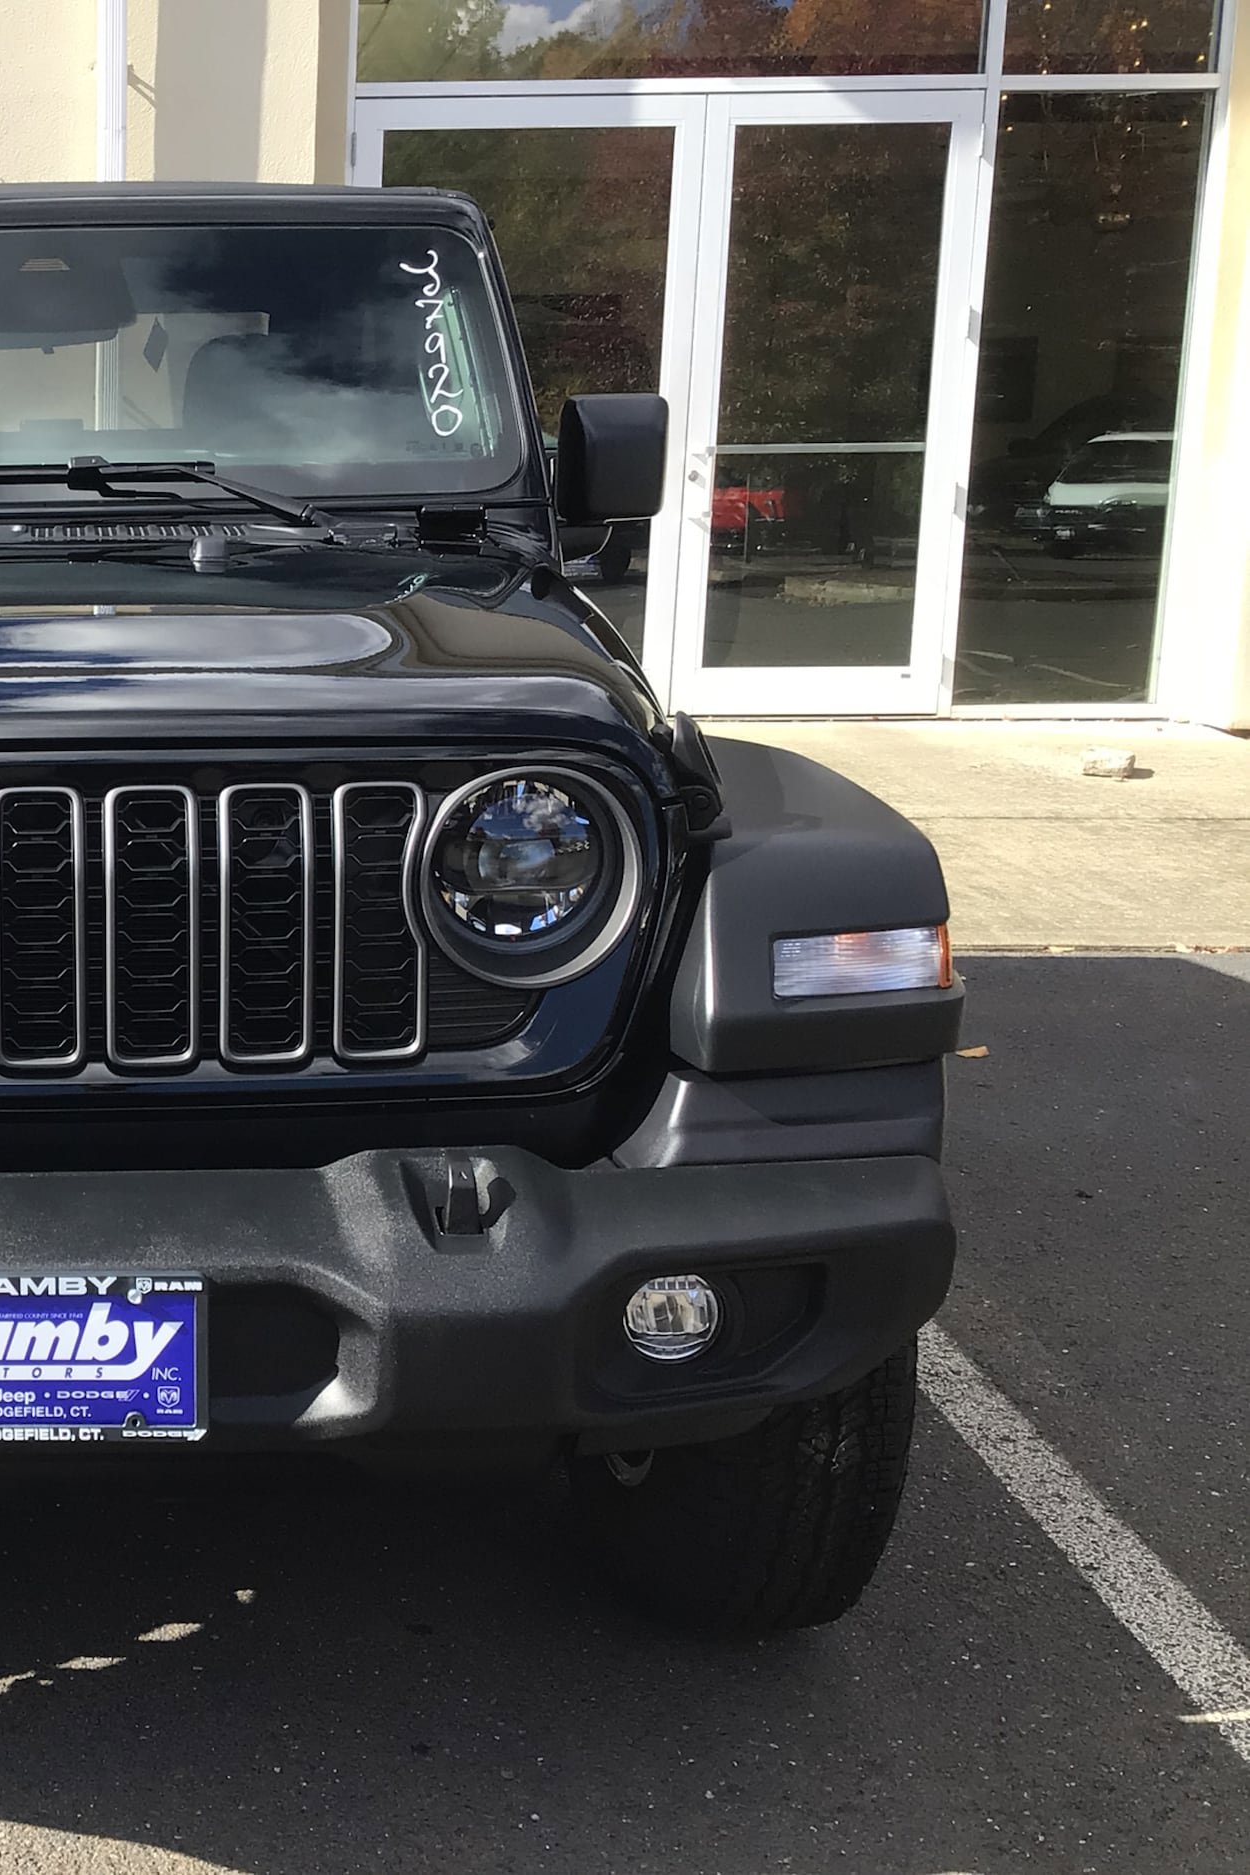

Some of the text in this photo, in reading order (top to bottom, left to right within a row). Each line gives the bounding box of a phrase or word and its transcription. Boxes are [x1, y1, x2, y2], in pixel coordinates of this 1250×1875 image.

[154, 1281, 203, 1292] RAM
[151, 1367, 182, 1381] INC.
[56, 1390, 129, 1399] DODGE
[69, 1406, 92, 1418] CT.
[78, 1429, 105, 1442] CT.
[122, 1430, 196, 1438] DODGE
